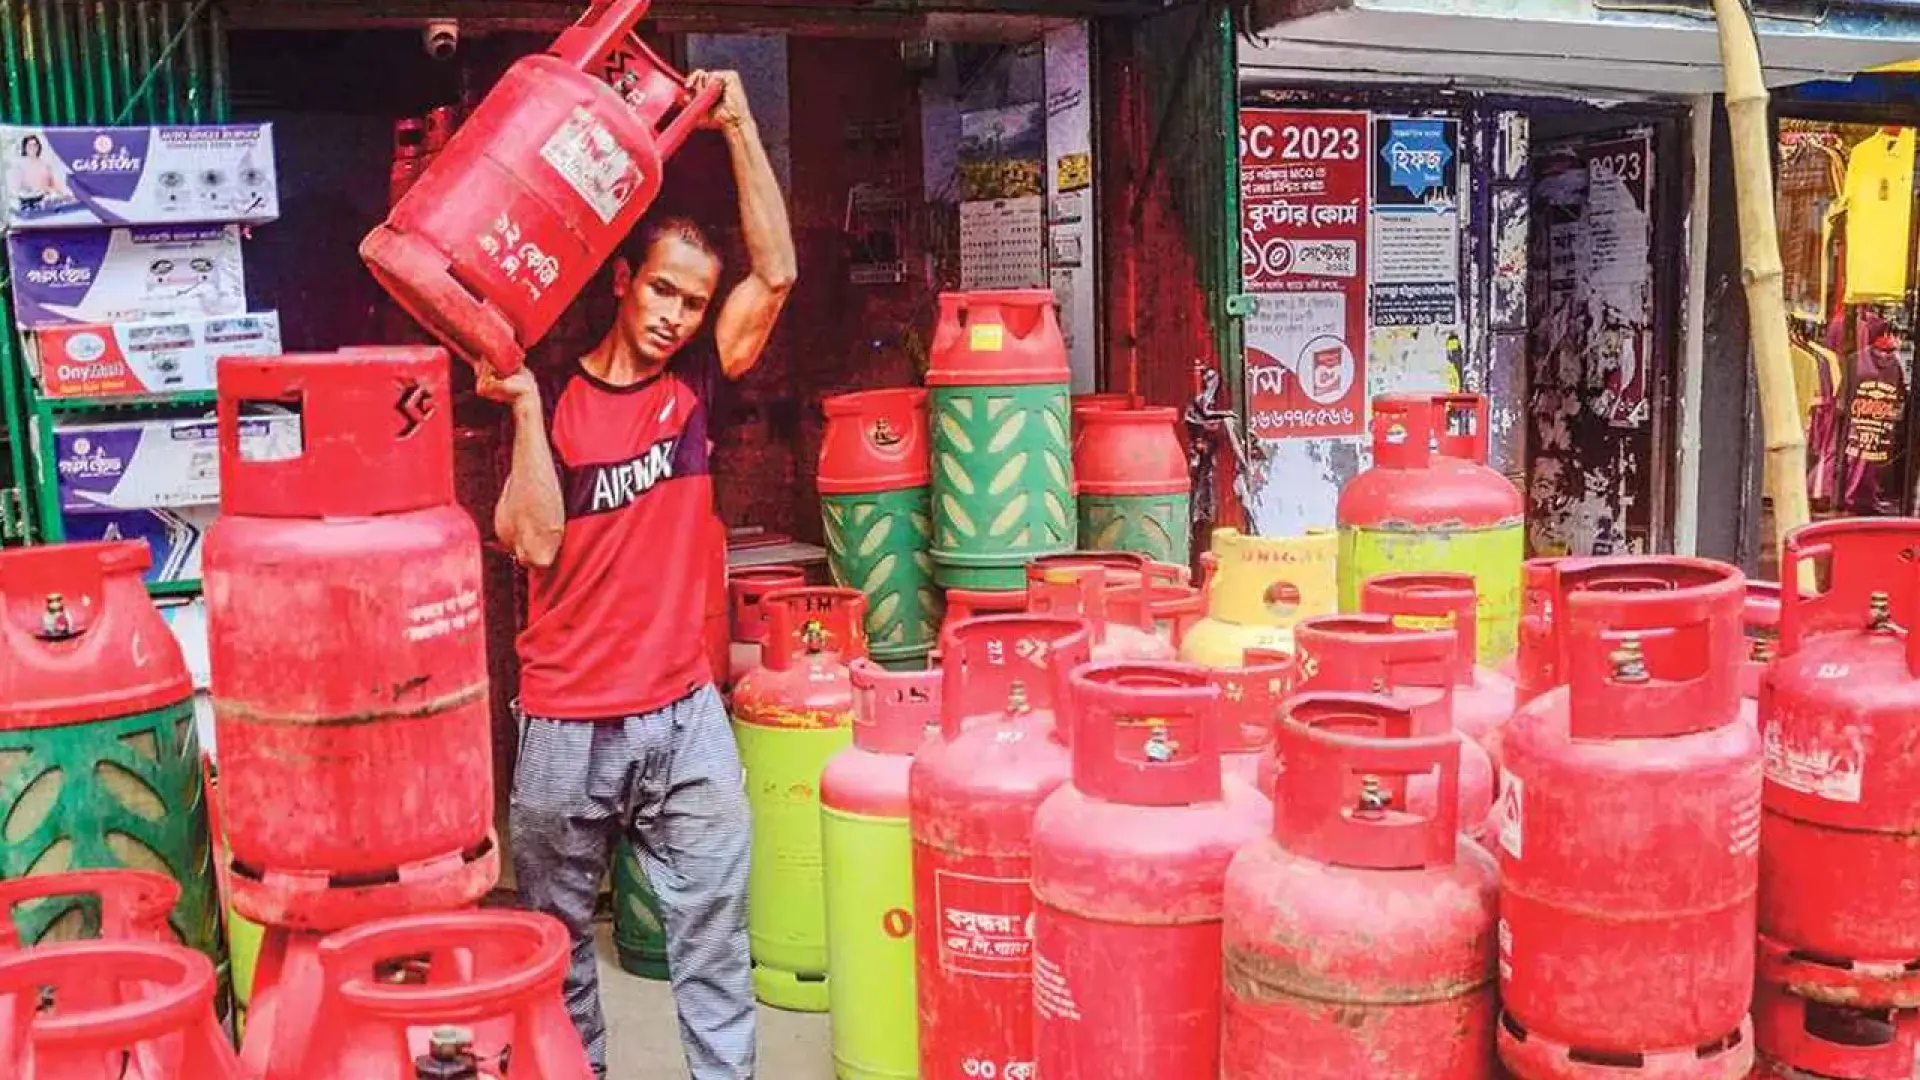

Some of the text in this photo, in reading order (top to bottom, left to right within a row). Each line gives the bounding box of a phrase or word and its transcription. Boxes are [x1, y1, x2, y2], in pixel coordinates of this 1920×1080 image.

[1282, 126, 1360, 161] 2023
[1392, 142, 1443, 174] হিফজ
[1289, 167, 1314, 179] MCQ
[1247, 198, 1361, 231] বুস্টার কোর্স
